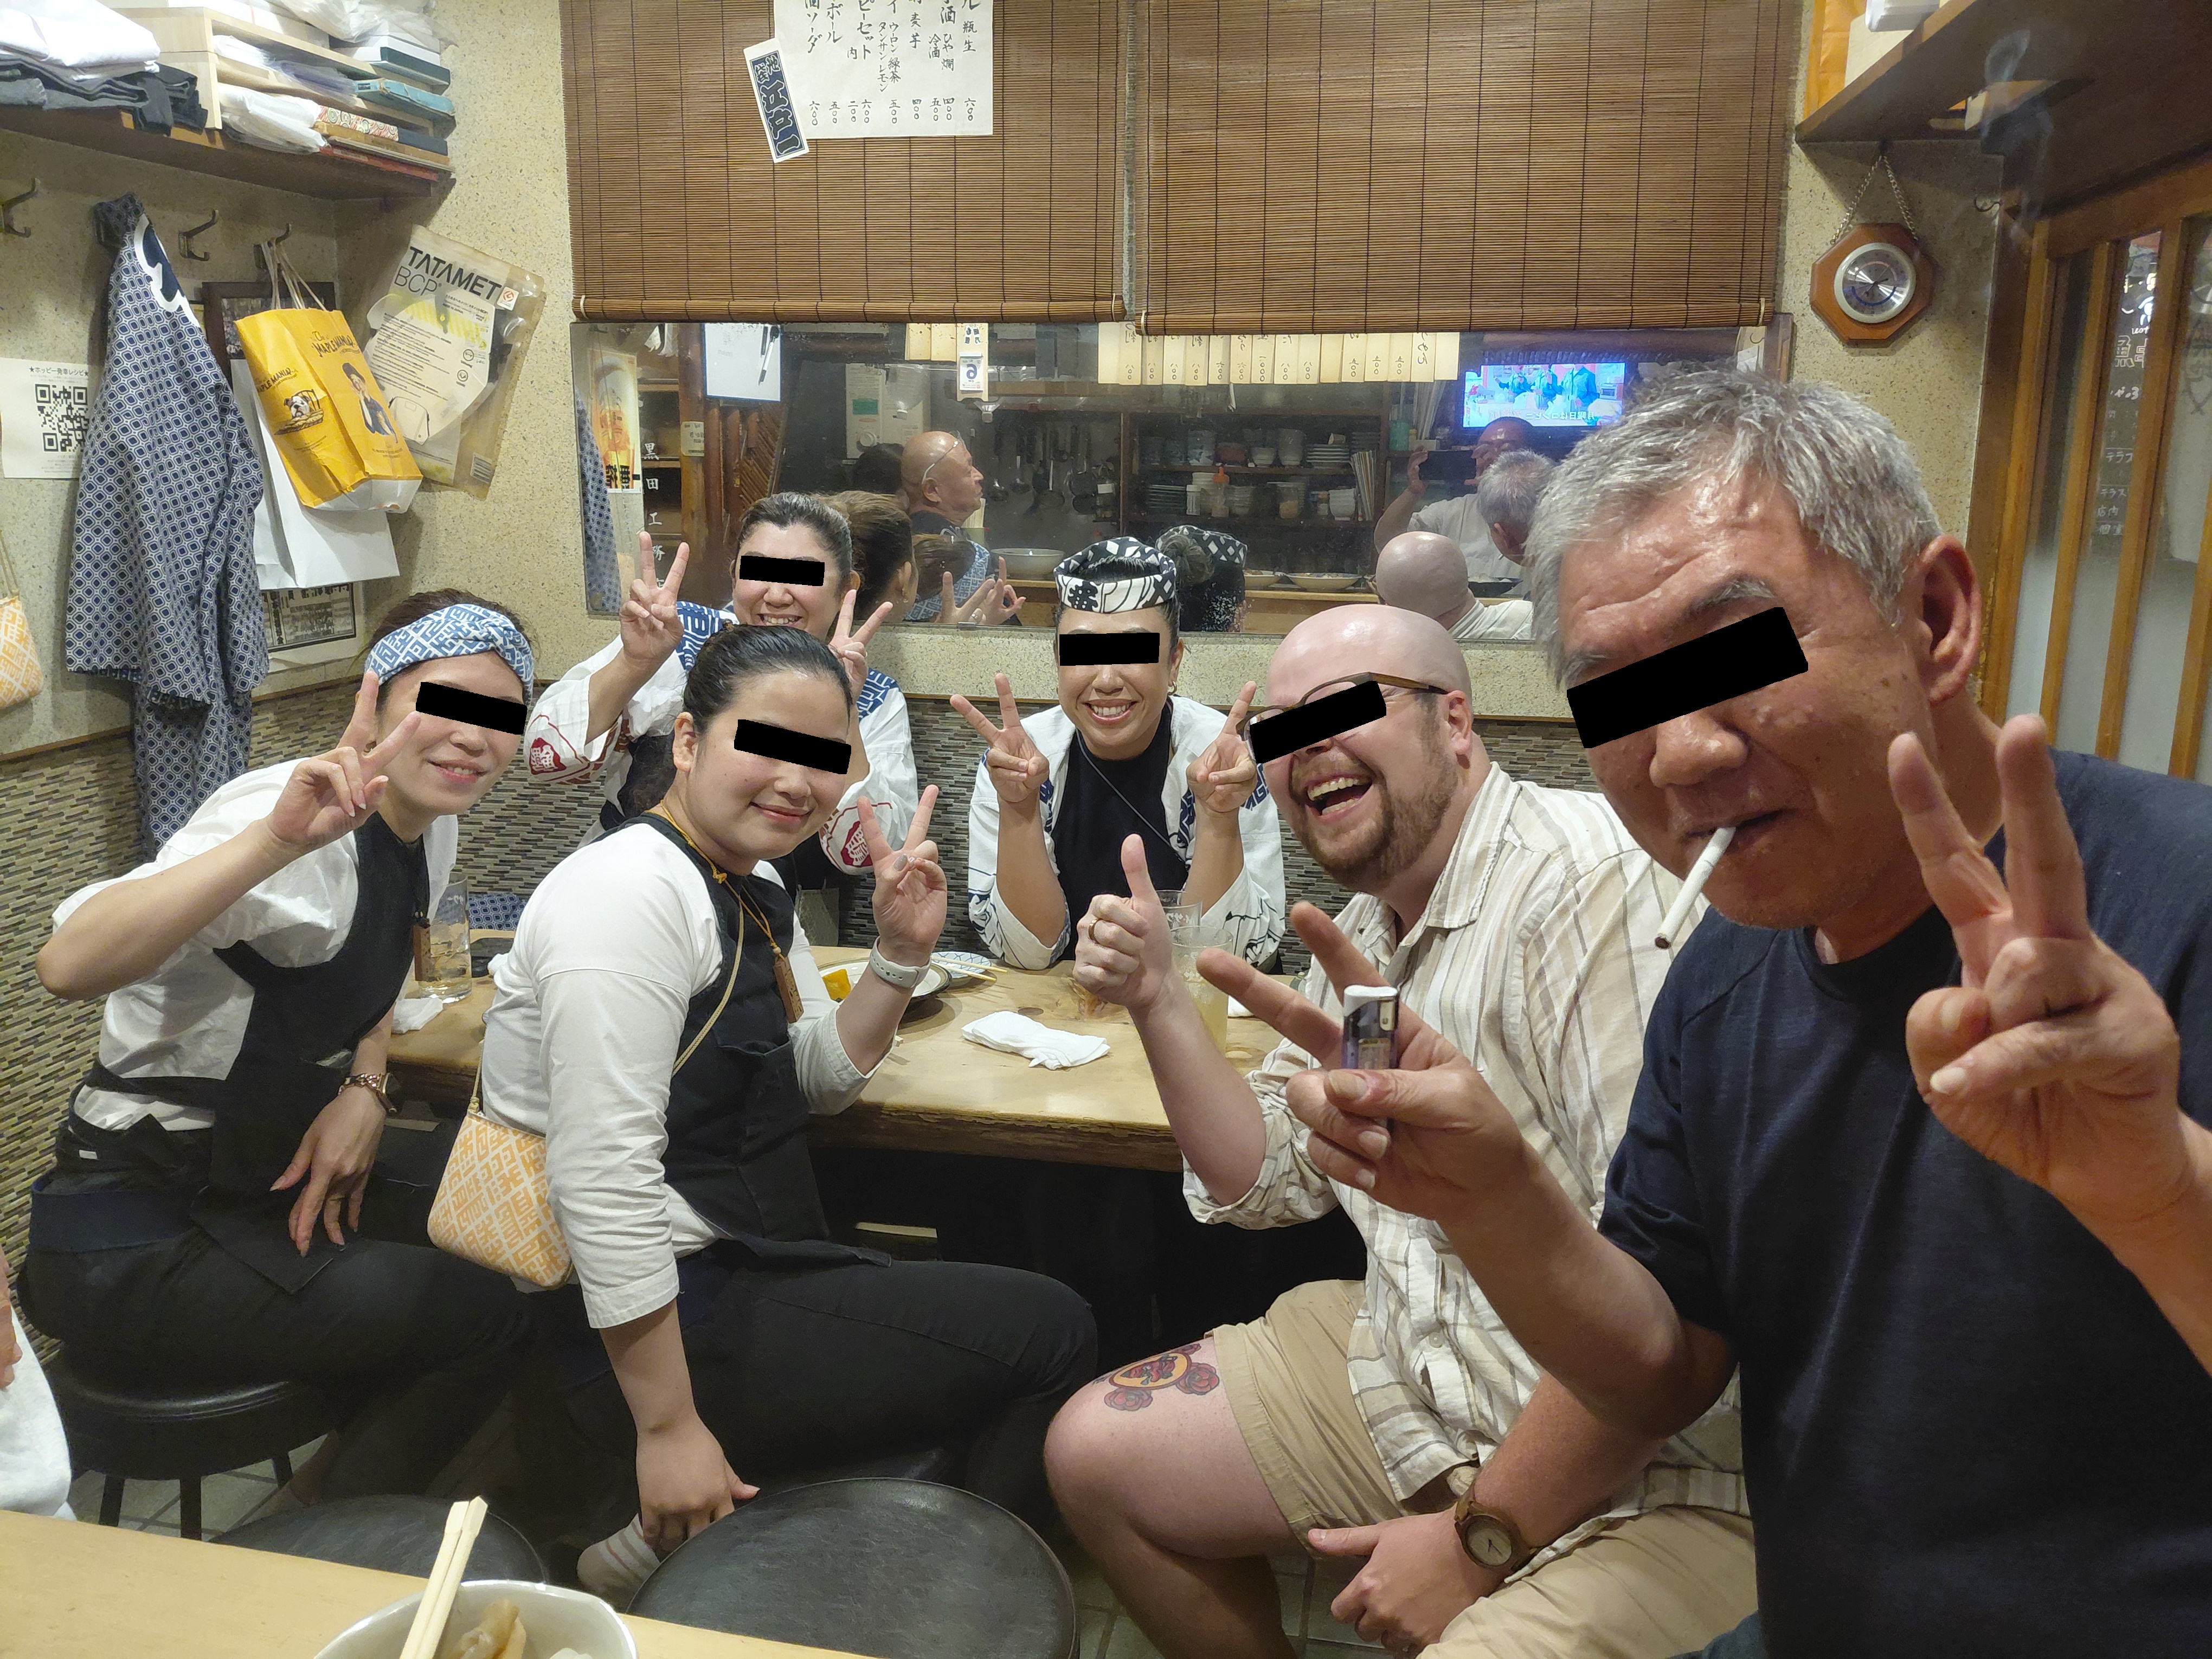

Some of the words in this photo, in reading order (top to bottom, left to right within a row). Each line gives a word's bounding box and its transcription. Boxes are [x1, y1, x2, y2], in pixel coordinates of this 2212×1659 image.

[928, 34, 941, 59] 冷酒
[760, 80, 800, 154] 江戸一
[410, 246, 502, 300] TATAMET
